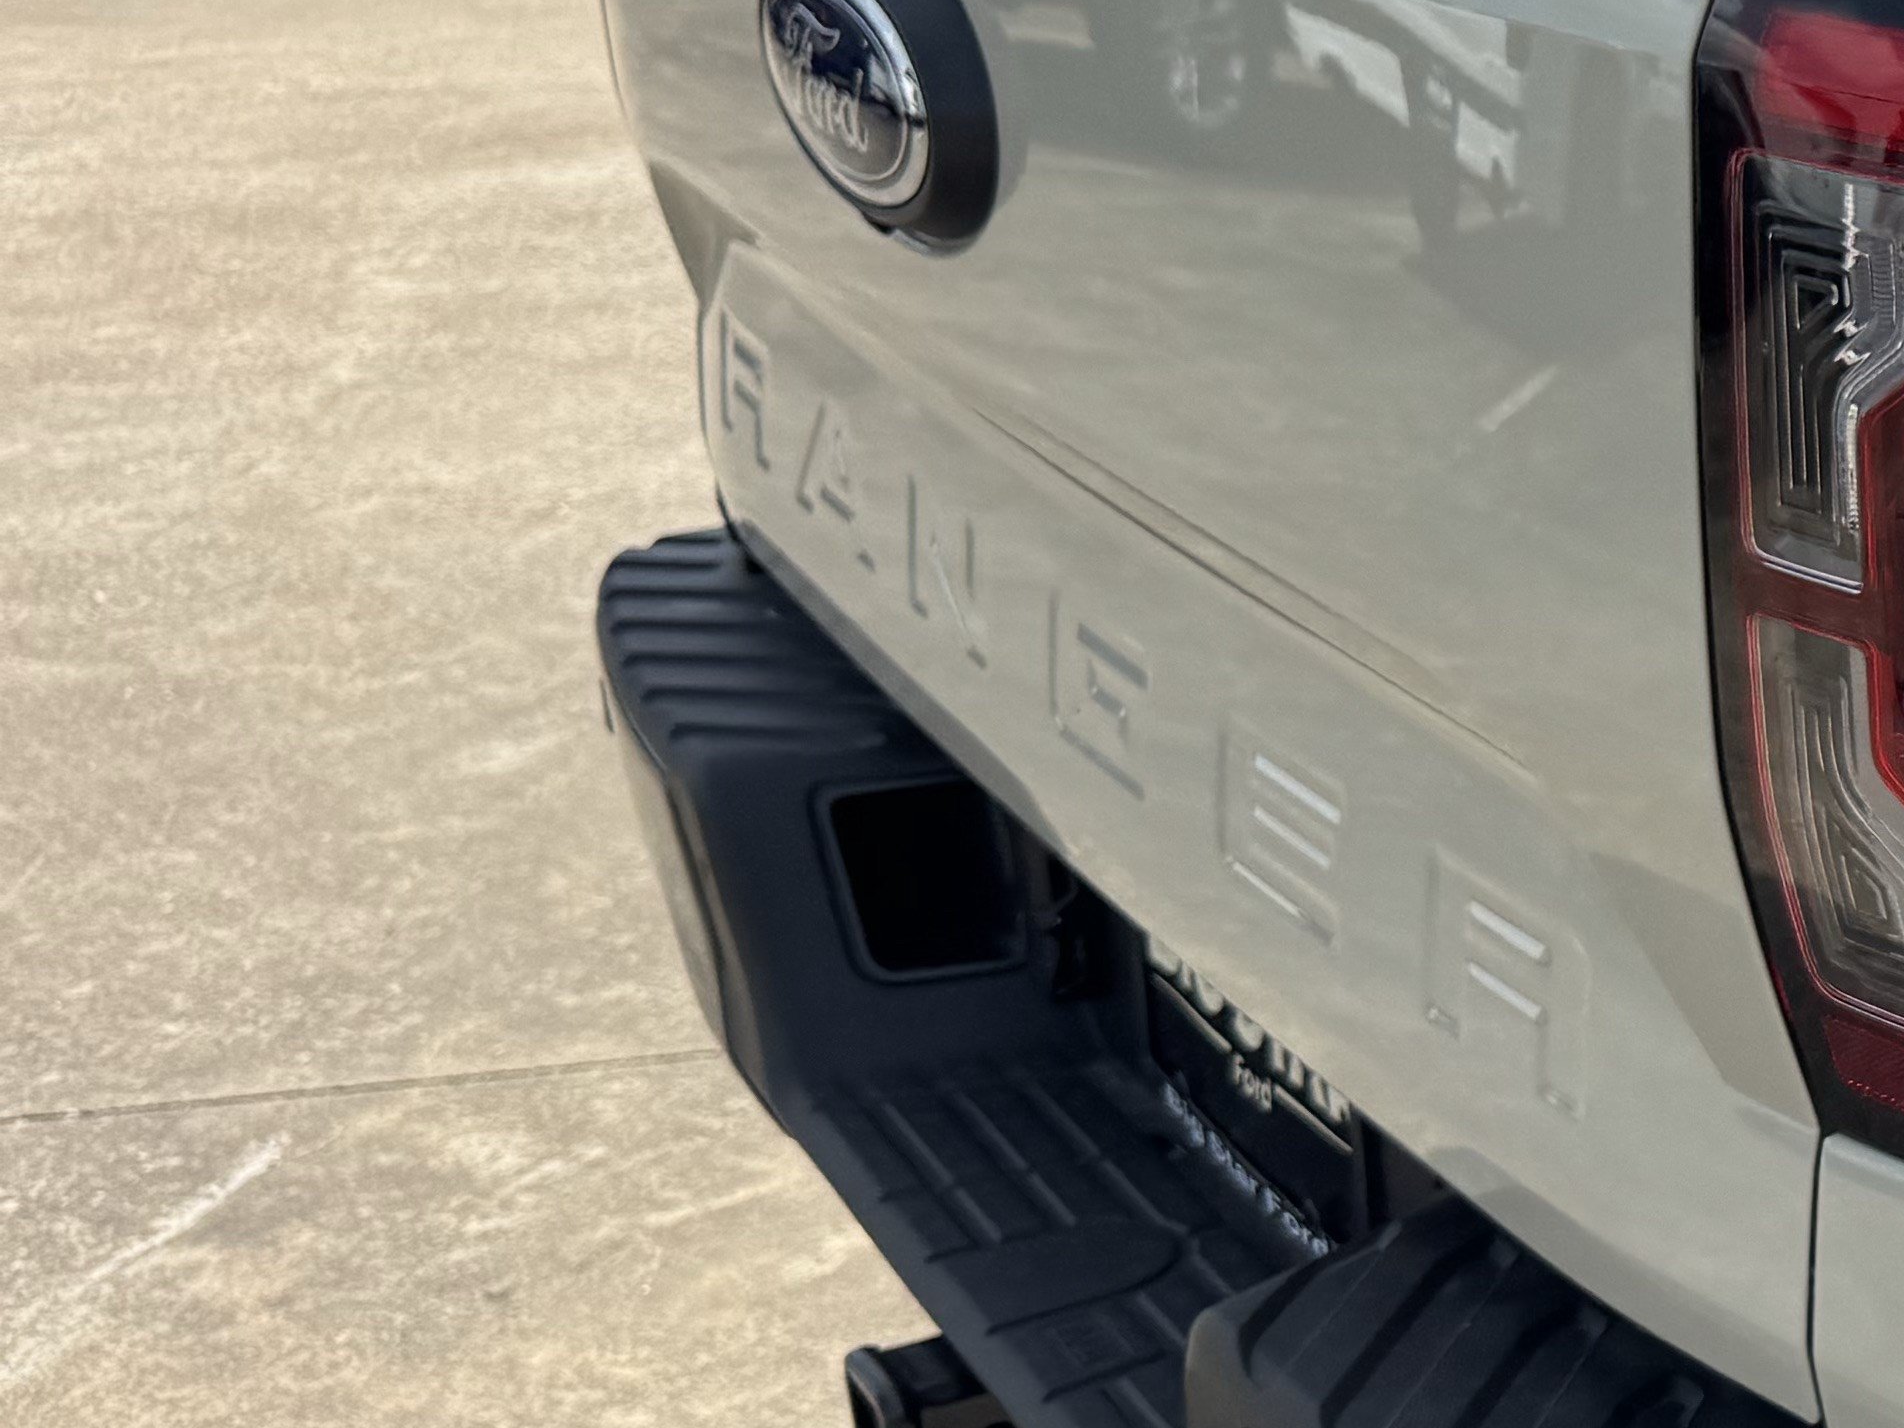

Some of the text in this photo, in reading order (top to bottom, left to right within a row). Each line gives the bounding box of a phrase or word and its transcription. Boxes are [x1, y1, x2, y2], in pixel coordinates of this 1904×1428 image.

[784, 0, 869, 153] Ford
[720, 304, 1592, 1122] RANGER
[1229, 1050, 1273, 1113] Ford
